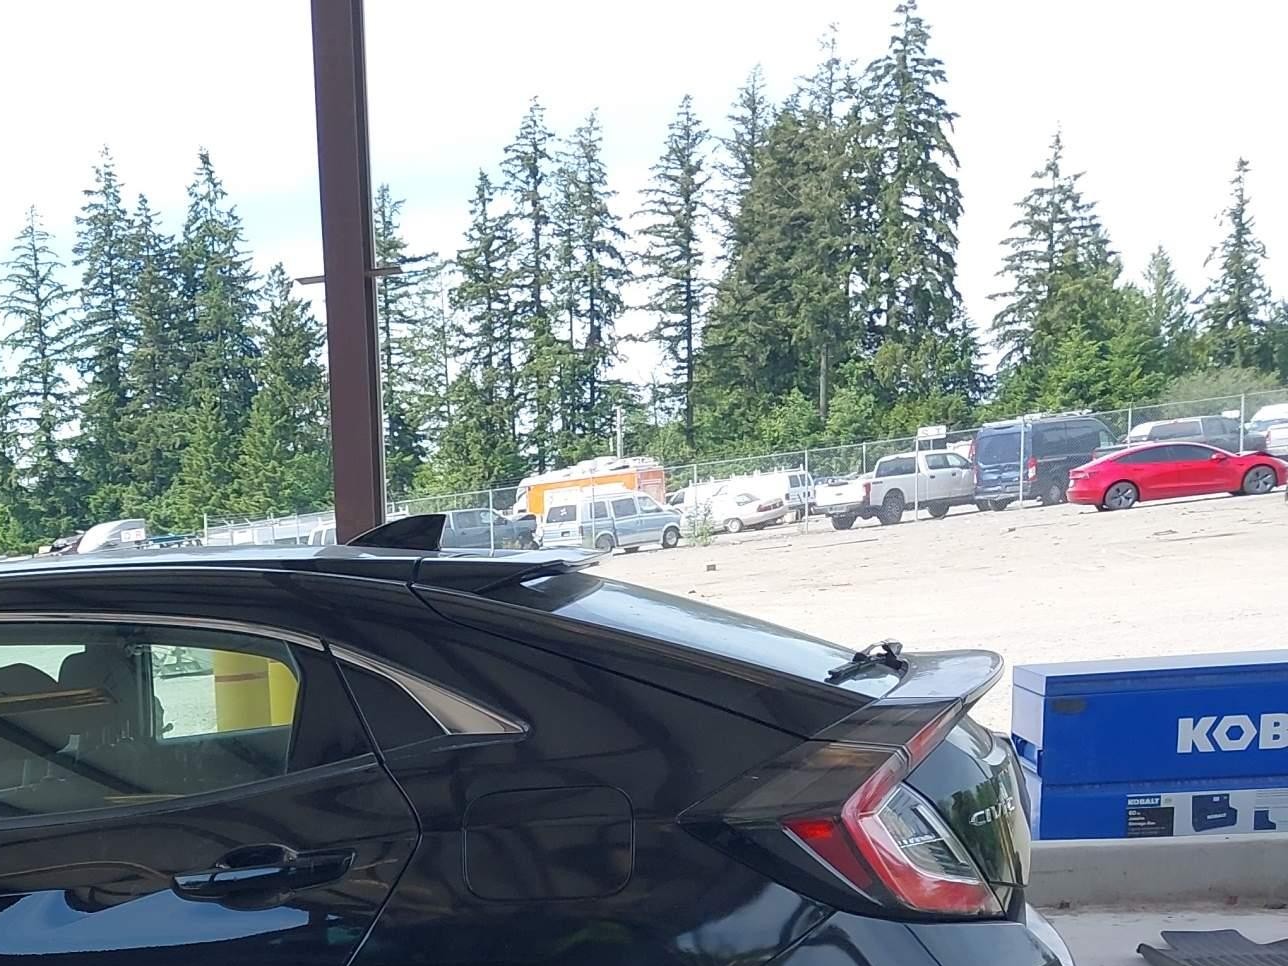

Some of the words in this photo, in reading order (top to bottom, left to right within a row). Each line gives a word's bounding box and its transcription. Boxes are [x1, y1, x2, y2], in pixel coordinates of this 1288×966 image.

[1176, 712, 1288, 754] KOB
[968, 796, 1015, 827] CIVIC
[1127, 797, 1160, 806] KOBALT
